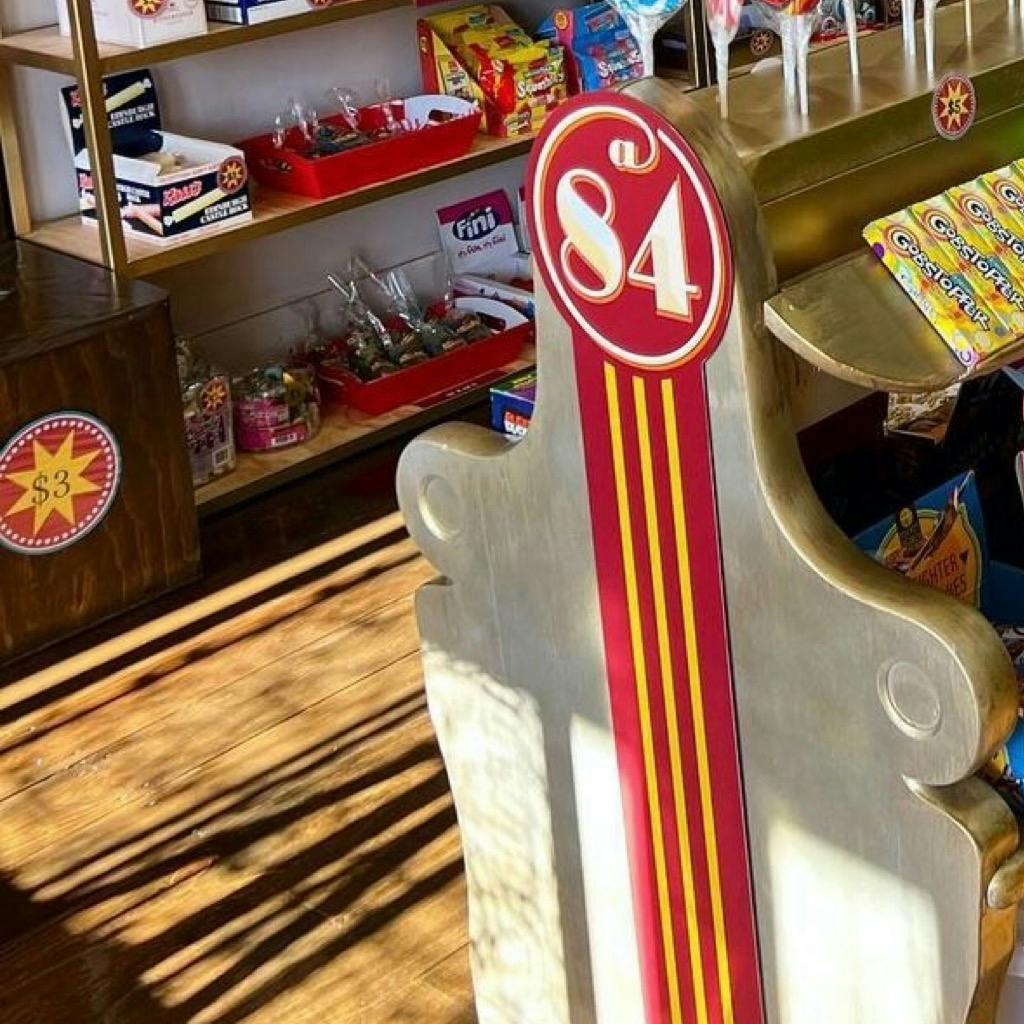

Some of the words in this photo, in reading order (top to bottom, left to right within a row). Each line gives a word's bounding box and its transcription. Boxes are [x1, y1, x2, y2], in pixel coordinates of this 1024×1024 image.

[948, 98, 961, 115] $5
[556, 168, 702, 323] 84
[31, 469, 72, 507] $3
